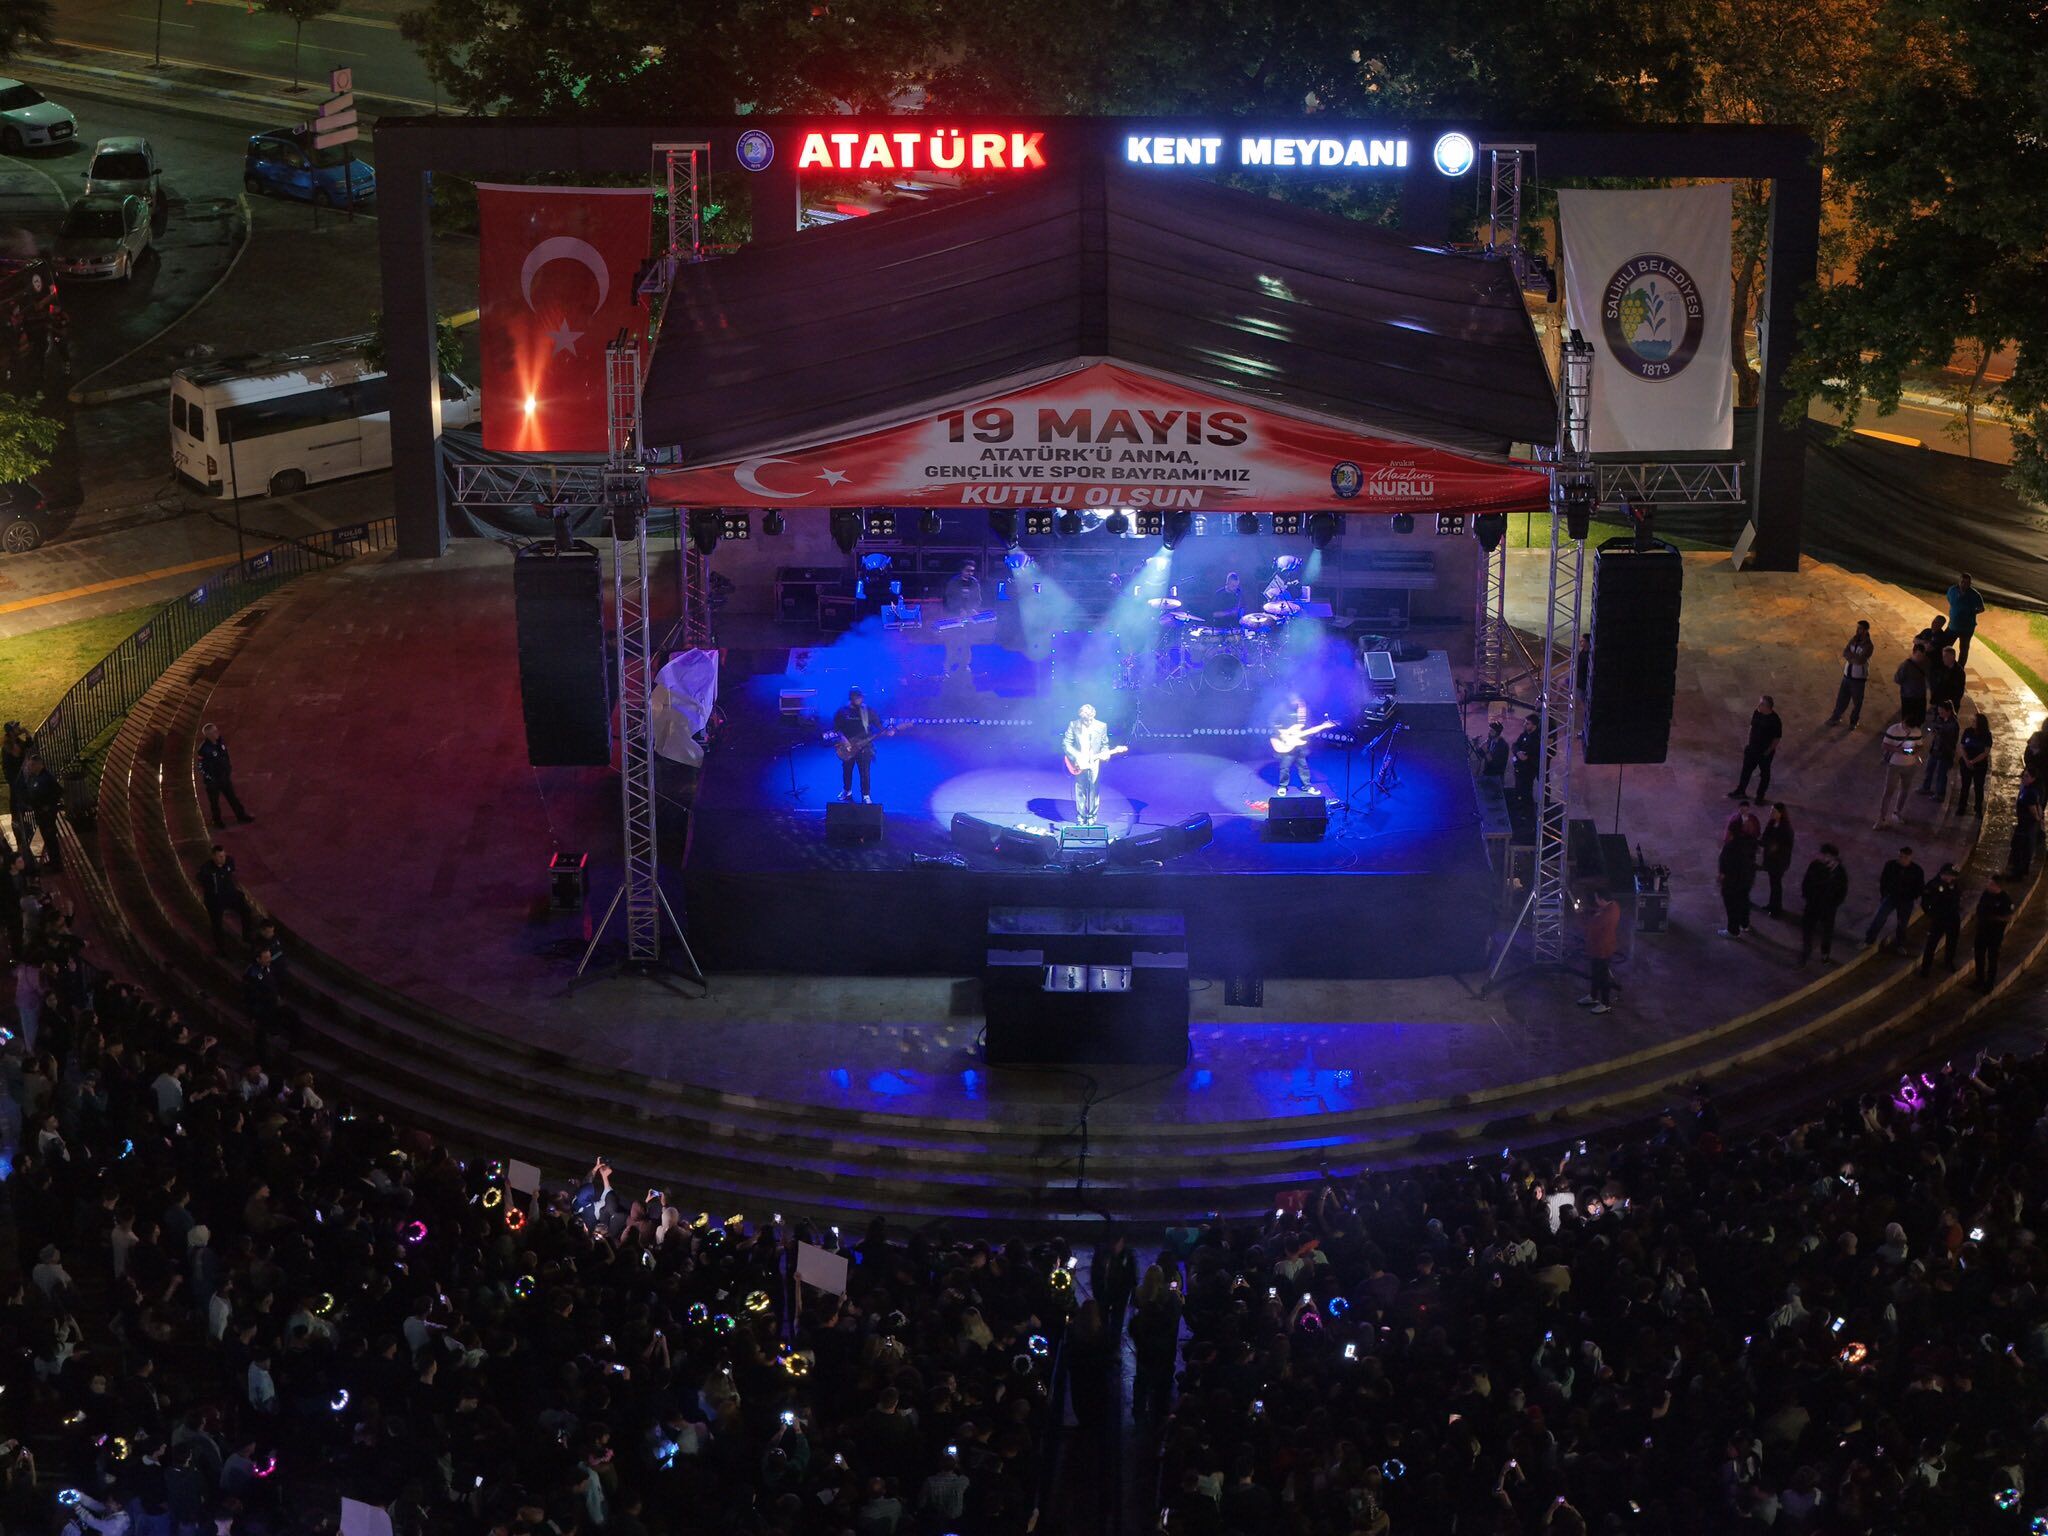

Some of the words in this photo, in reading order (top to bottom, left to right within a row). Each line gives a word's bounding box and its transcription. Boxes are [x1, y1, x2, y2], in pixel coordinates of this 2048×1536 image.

[798, 129, 1046, 169] ATATÜRK
[1128, 137, 1221, 164] KENT
[1241, 139, 1408, 167] MEYDANI
[1607, 264, 1637, 319] SALİHLİ
[1638, 260, 1701, 319] BELEDİYESİ
[1642, 363, 1670, 376] 1879
[937, 408, 1014, 443] 19
[1038, 408, 1248, 446] MAYIS
[980, 446, 1112, 463] ATATÜRK'Ü
[1122, 450, 1199, 465] ANMA,
[925, 464, 1014, 480] GENÇLİK
[1018, 466, 1044, 479] VE
[1049, 466, 1106, 479] SPOR
[1111, 467, 1251, 482] BAYRAMI'MIZ
[1370, 468, 1434, 481] Mazlum
[960, 486, 1075, 505] KUTLU
[1084, 487, 1204, 508] OLSUN
[1369, 481, 1434, 496] NURLU
